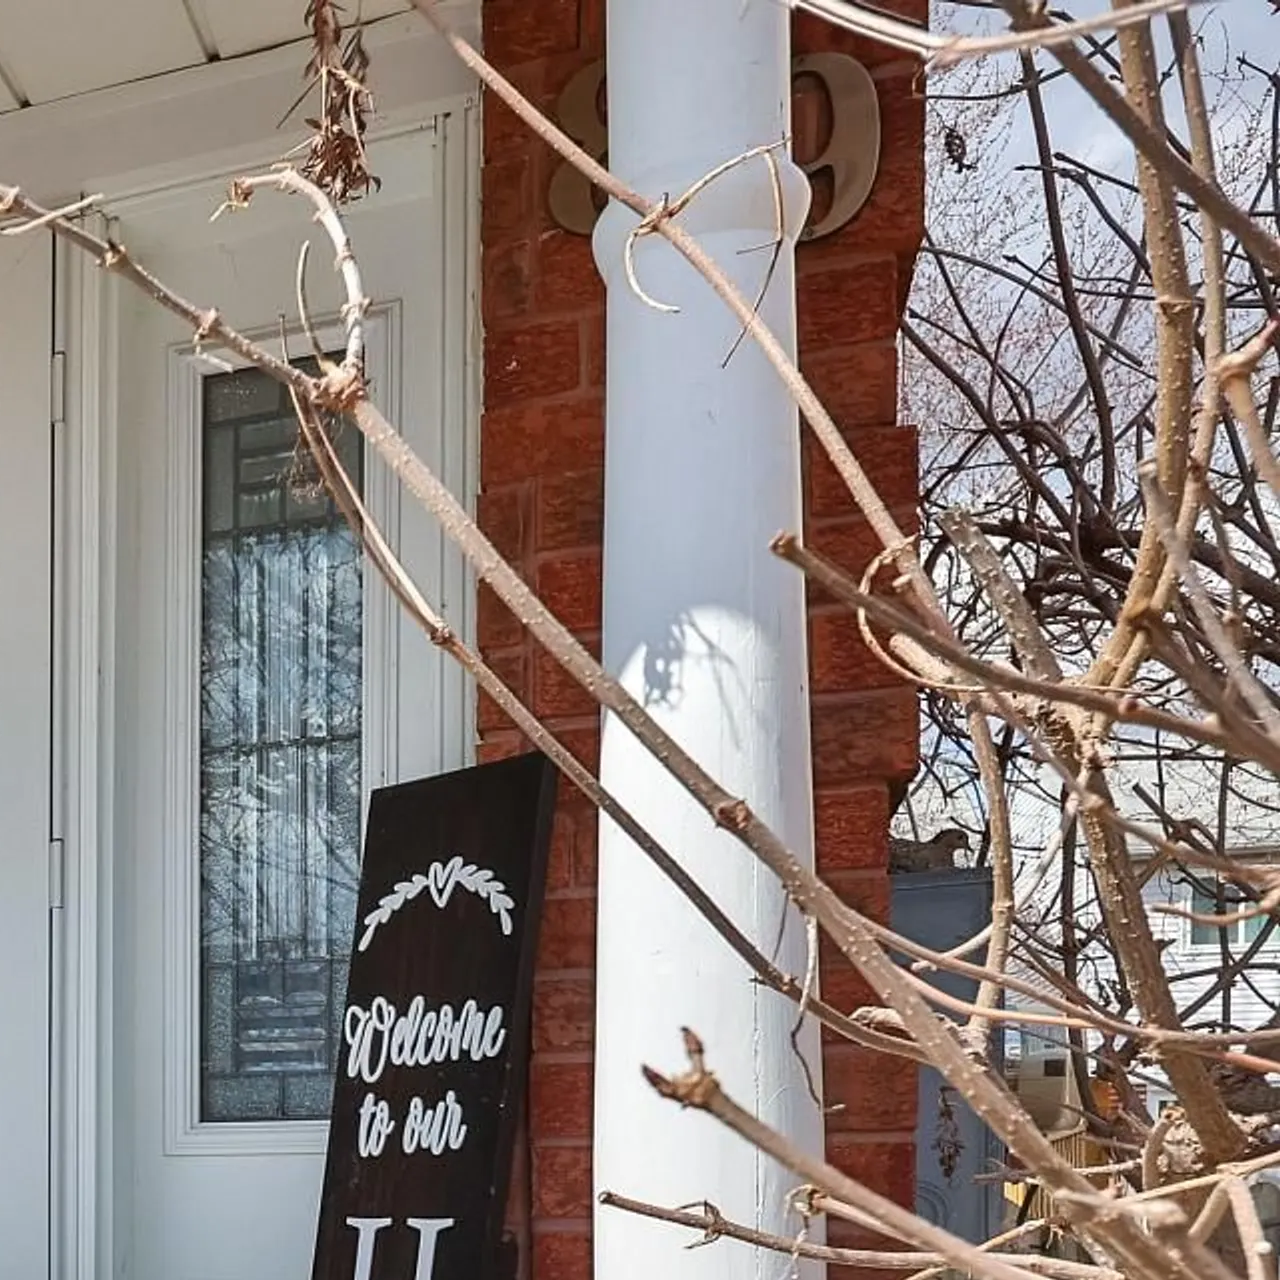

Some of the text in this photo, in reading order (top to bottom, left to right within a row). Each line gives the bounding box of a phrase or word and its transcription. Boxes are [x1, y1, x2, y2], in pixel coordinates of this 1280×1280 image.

[345, 995, 506, 1083] Welcome
[358, 1090, 467, 1158] to our
